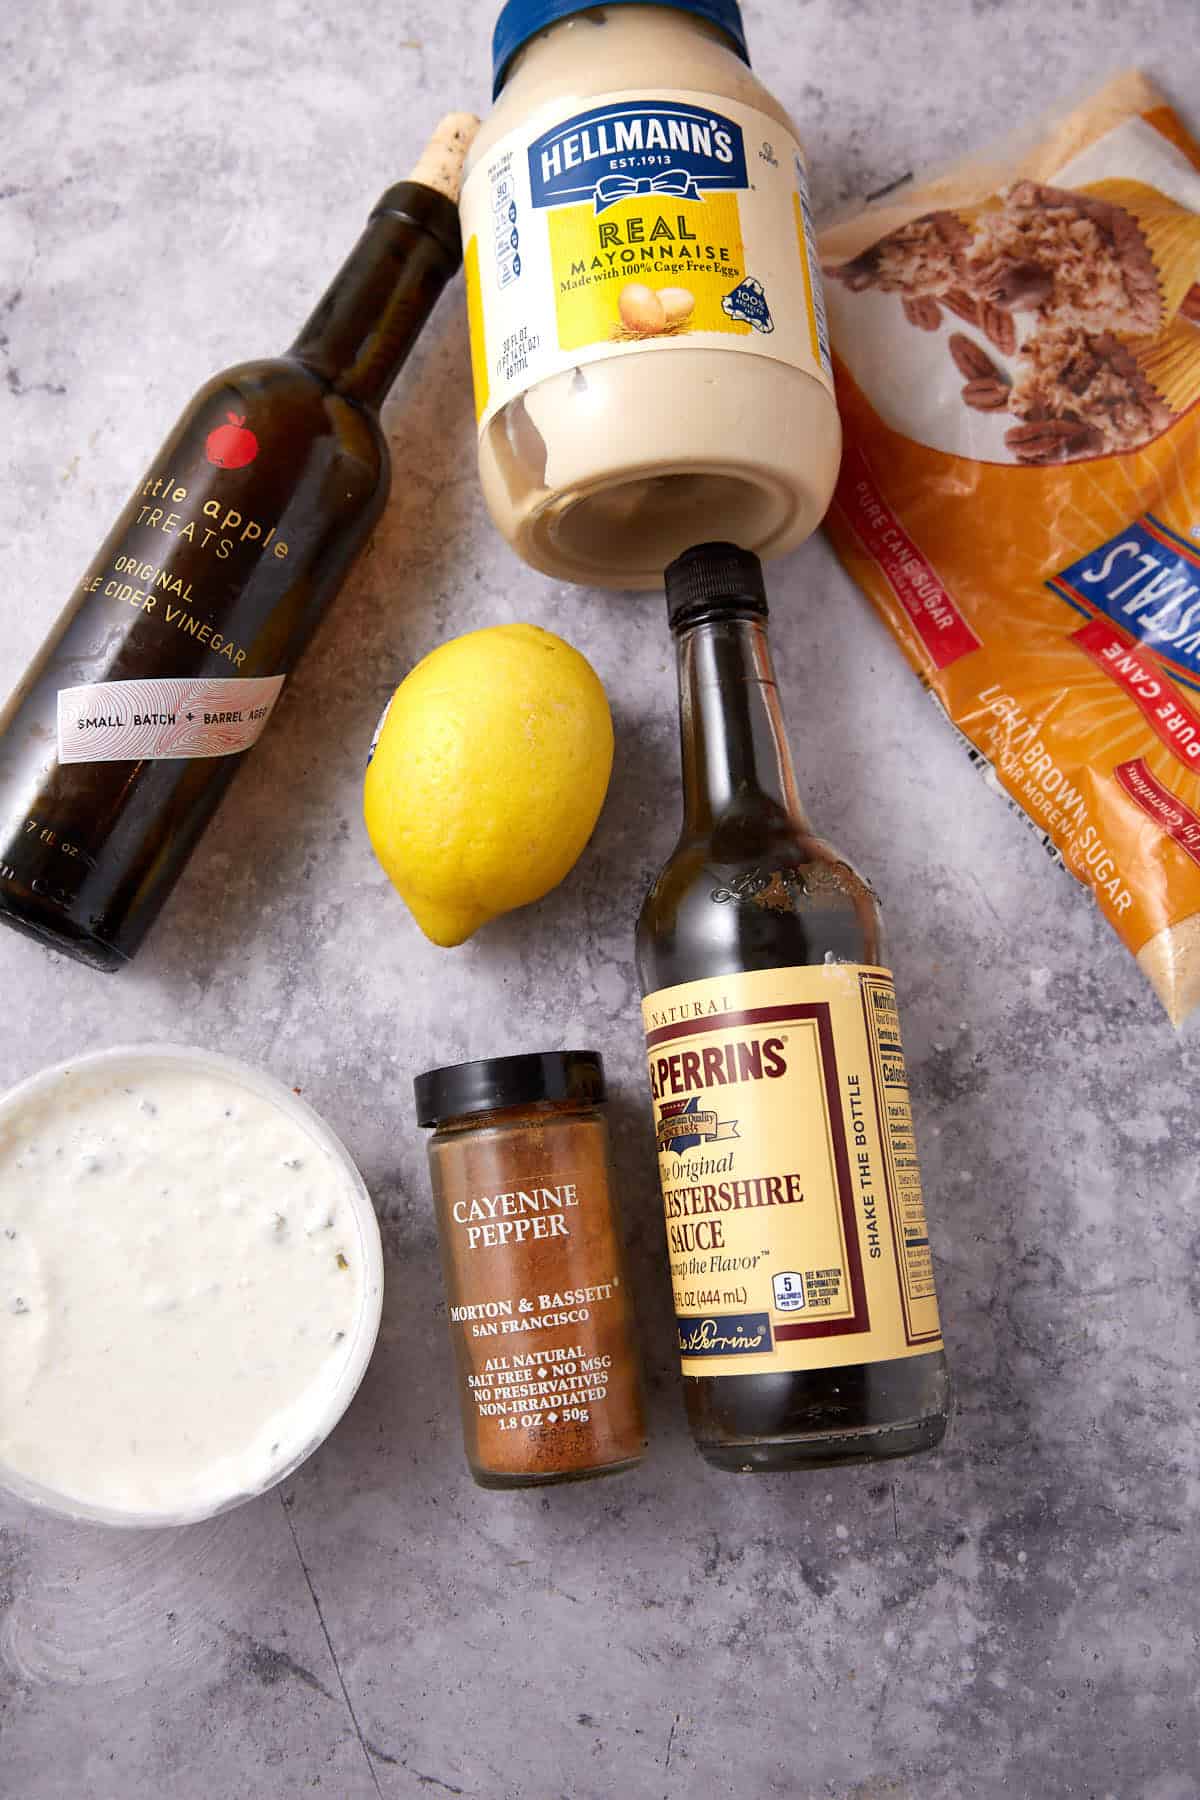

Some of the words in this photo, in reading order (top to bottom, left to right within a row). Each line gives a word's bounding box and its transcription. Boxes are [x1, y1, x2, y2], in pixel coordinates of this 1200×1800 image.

[540, 118, 733, 183] HELLMANN'S
[610, 155, 672, 170] EST.1913
[599, 215, 697, 249] REAL
[560, 276, 592, 294] Made
[594, 268, 619, 283] with
[621, 263, 651, 276] 100%
[653, 261, 685, 275] Cage
[687, 260, 713, 272] Free
[714, 262, 740, 279] Eggs
[570, 245, 731, 276] MAYONNAISE
[136, 505, 234, 559] TREATS
[138, 478, 188, 503] ttle
[203, 500, 289, 559] apple
[856, 481, 888, 529] PURE
[881, 528, 921, 574] CANE
[911, 572, 954, 631] SUGAR
[115, 556, 193, 603] ORIGINAL
[104, 581, 157, 613] CIDER
[165, 604, 247, 668] VINEGAR
[1102, 641, 1162, 699] CANE
[78, 715, 125, 730] SMALL
[134, 713, 176, 726] BATCH
[204, 710, 244, 725] BARREL
[1156, 702, 1200, 758] PURE
[1127, 766, 1184, 827] Generations
[1023, 740, 1089, 828] BROWN
[1078, 825, 1133, 916] SUGAR
[652, 997, 732, 1026] NATURAL
[848, 1075, 866, 1146] BOTTLE
[672, 1152, 734, 1182] Original
[857, 1152, 872, 1189] THE
[453, 1184, 579, 1224] CAYENNE
[664, 1174, 804, 1218] ESTERSHIRE
[467, 1214, 570, 1249] PEPPER
[670, 1220, 725, 1254] SAUCE
[863, 1194, 881, 1259] SHAKE
[689, 1256, 706, 1275] the
[685, 1290, 696, 1307] OZ
[697, 1288, 720, 1310] (444
[723, 1286, 748, 1305] mL)
[784, 1277, 792, 1292] 5
[450, 1299, 512, 1322] MORTON
[518, 1297, 534, 1313] &
[539, 1283, 614, 1310] BASSETT
[472, 1322, 498, 1338] SAN
[501, 1309, 590, 1335] FRANCISCO
[467, 1373, 496, 1388] SALT
[497, 1368, 533, 1385] FREE
[552, 1361, 577, 1377] NO
[580, 1355, 612, 1373] MSG
[484, 1357, 510, 1372] ALL
[512, 1346, 586, 1367] NATURAL
[474, 1389, 492, 1403] NO
[494, 1371, 609, 1400] PRESERVATIVES
[479, 1386, 607, 1416] NON-IRRADIATED
[498, 1415, 518, 1431] 1.8
[521, 1411, 543, 1428] OZ
[562, 1407, 589, 1423] 50g
